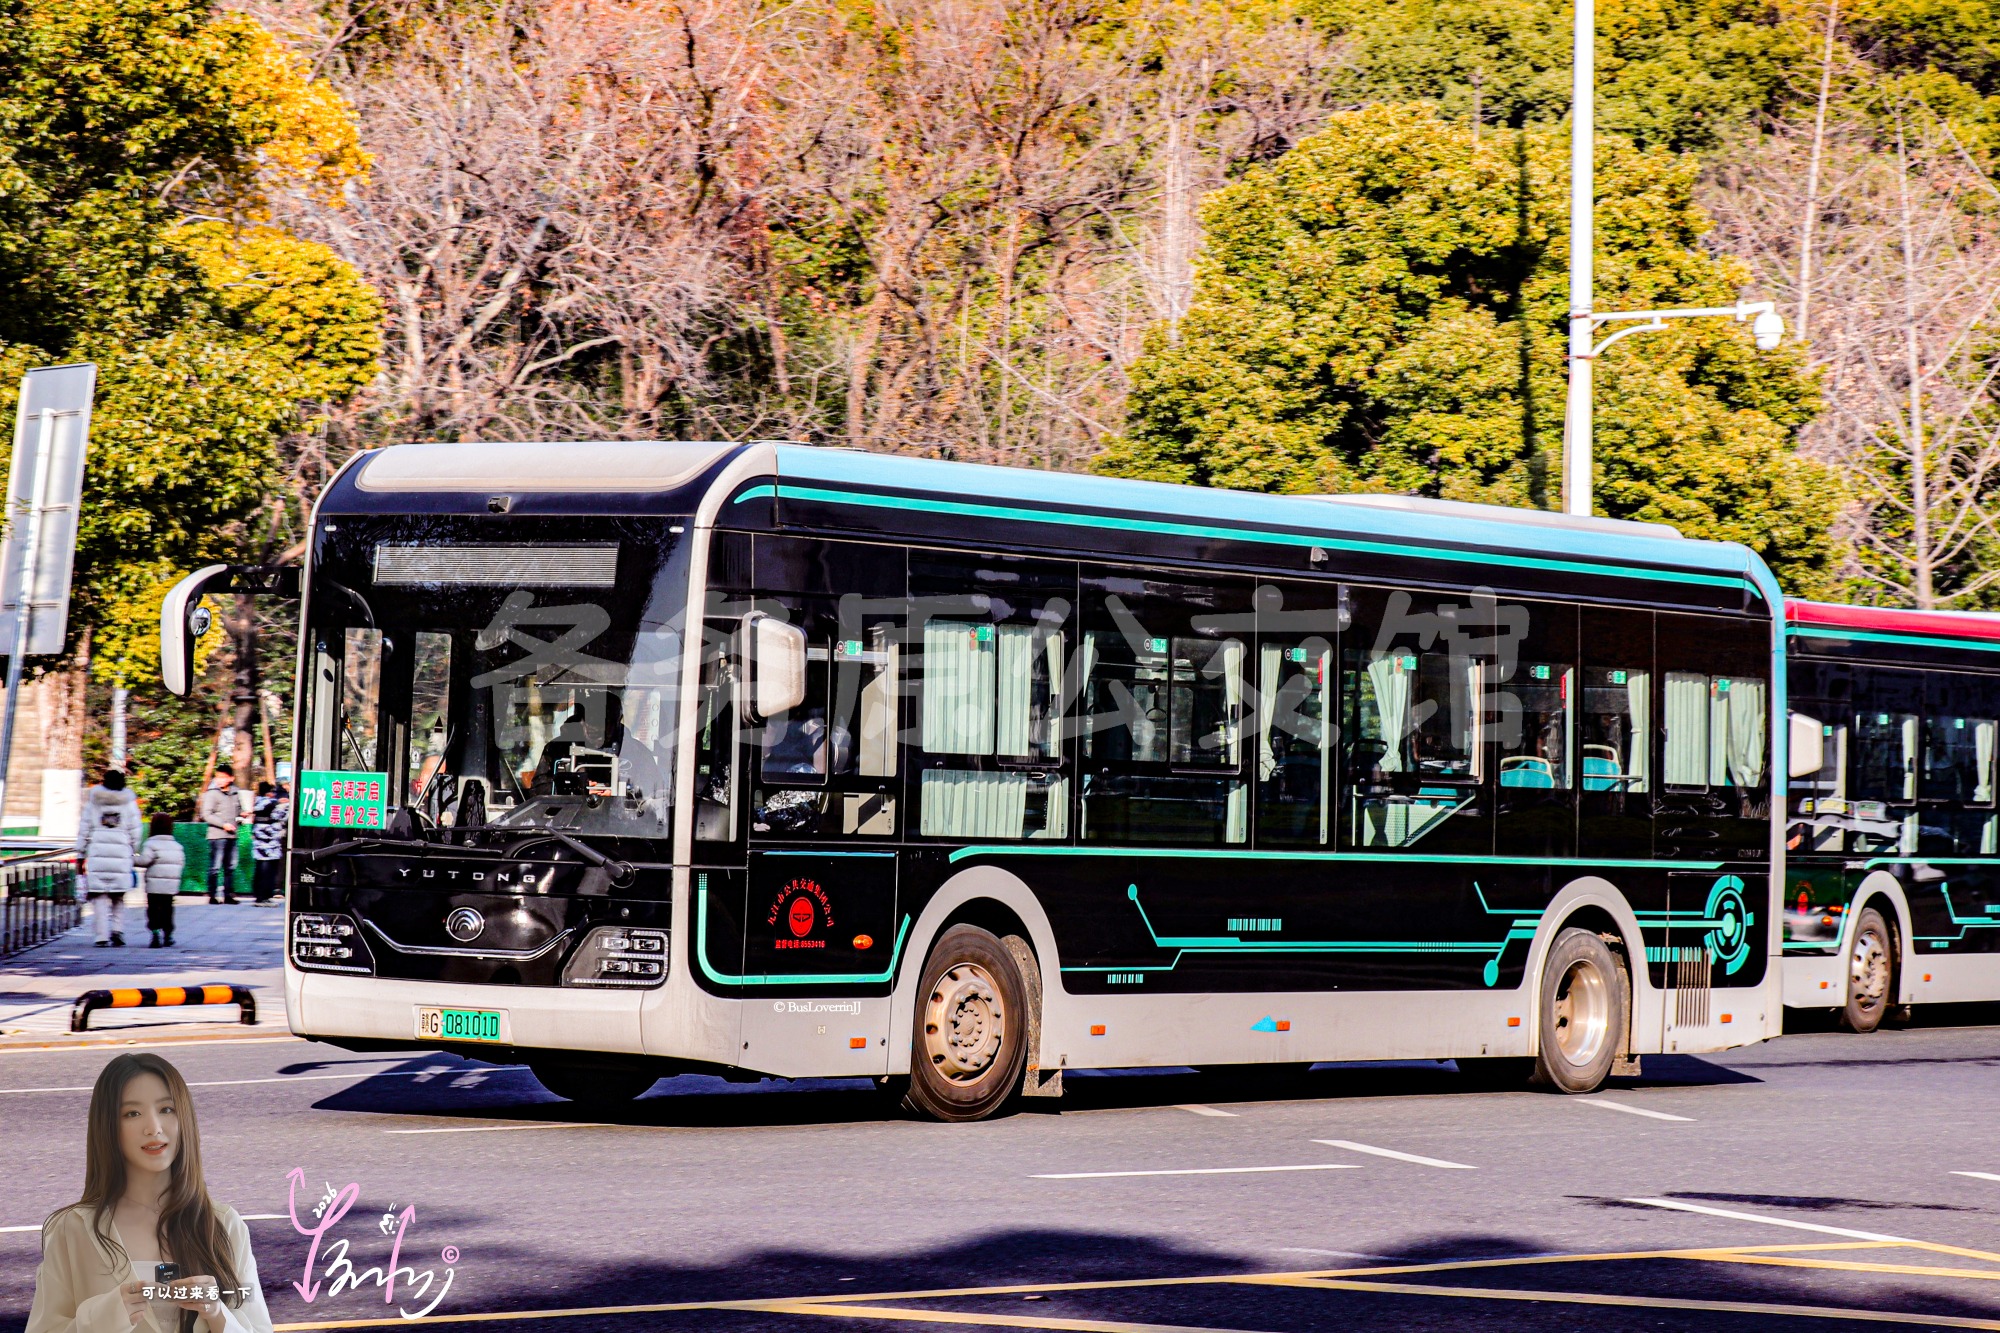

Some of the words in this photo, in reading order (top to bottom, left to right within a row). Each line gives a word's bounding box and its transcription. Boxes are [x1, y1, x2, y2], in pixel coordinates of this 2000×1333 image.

[331, 780, 380, 801] 空调开启
[329, 805, 379, 827] 票价2元
[398, 868, 537, 884] YUTONG
